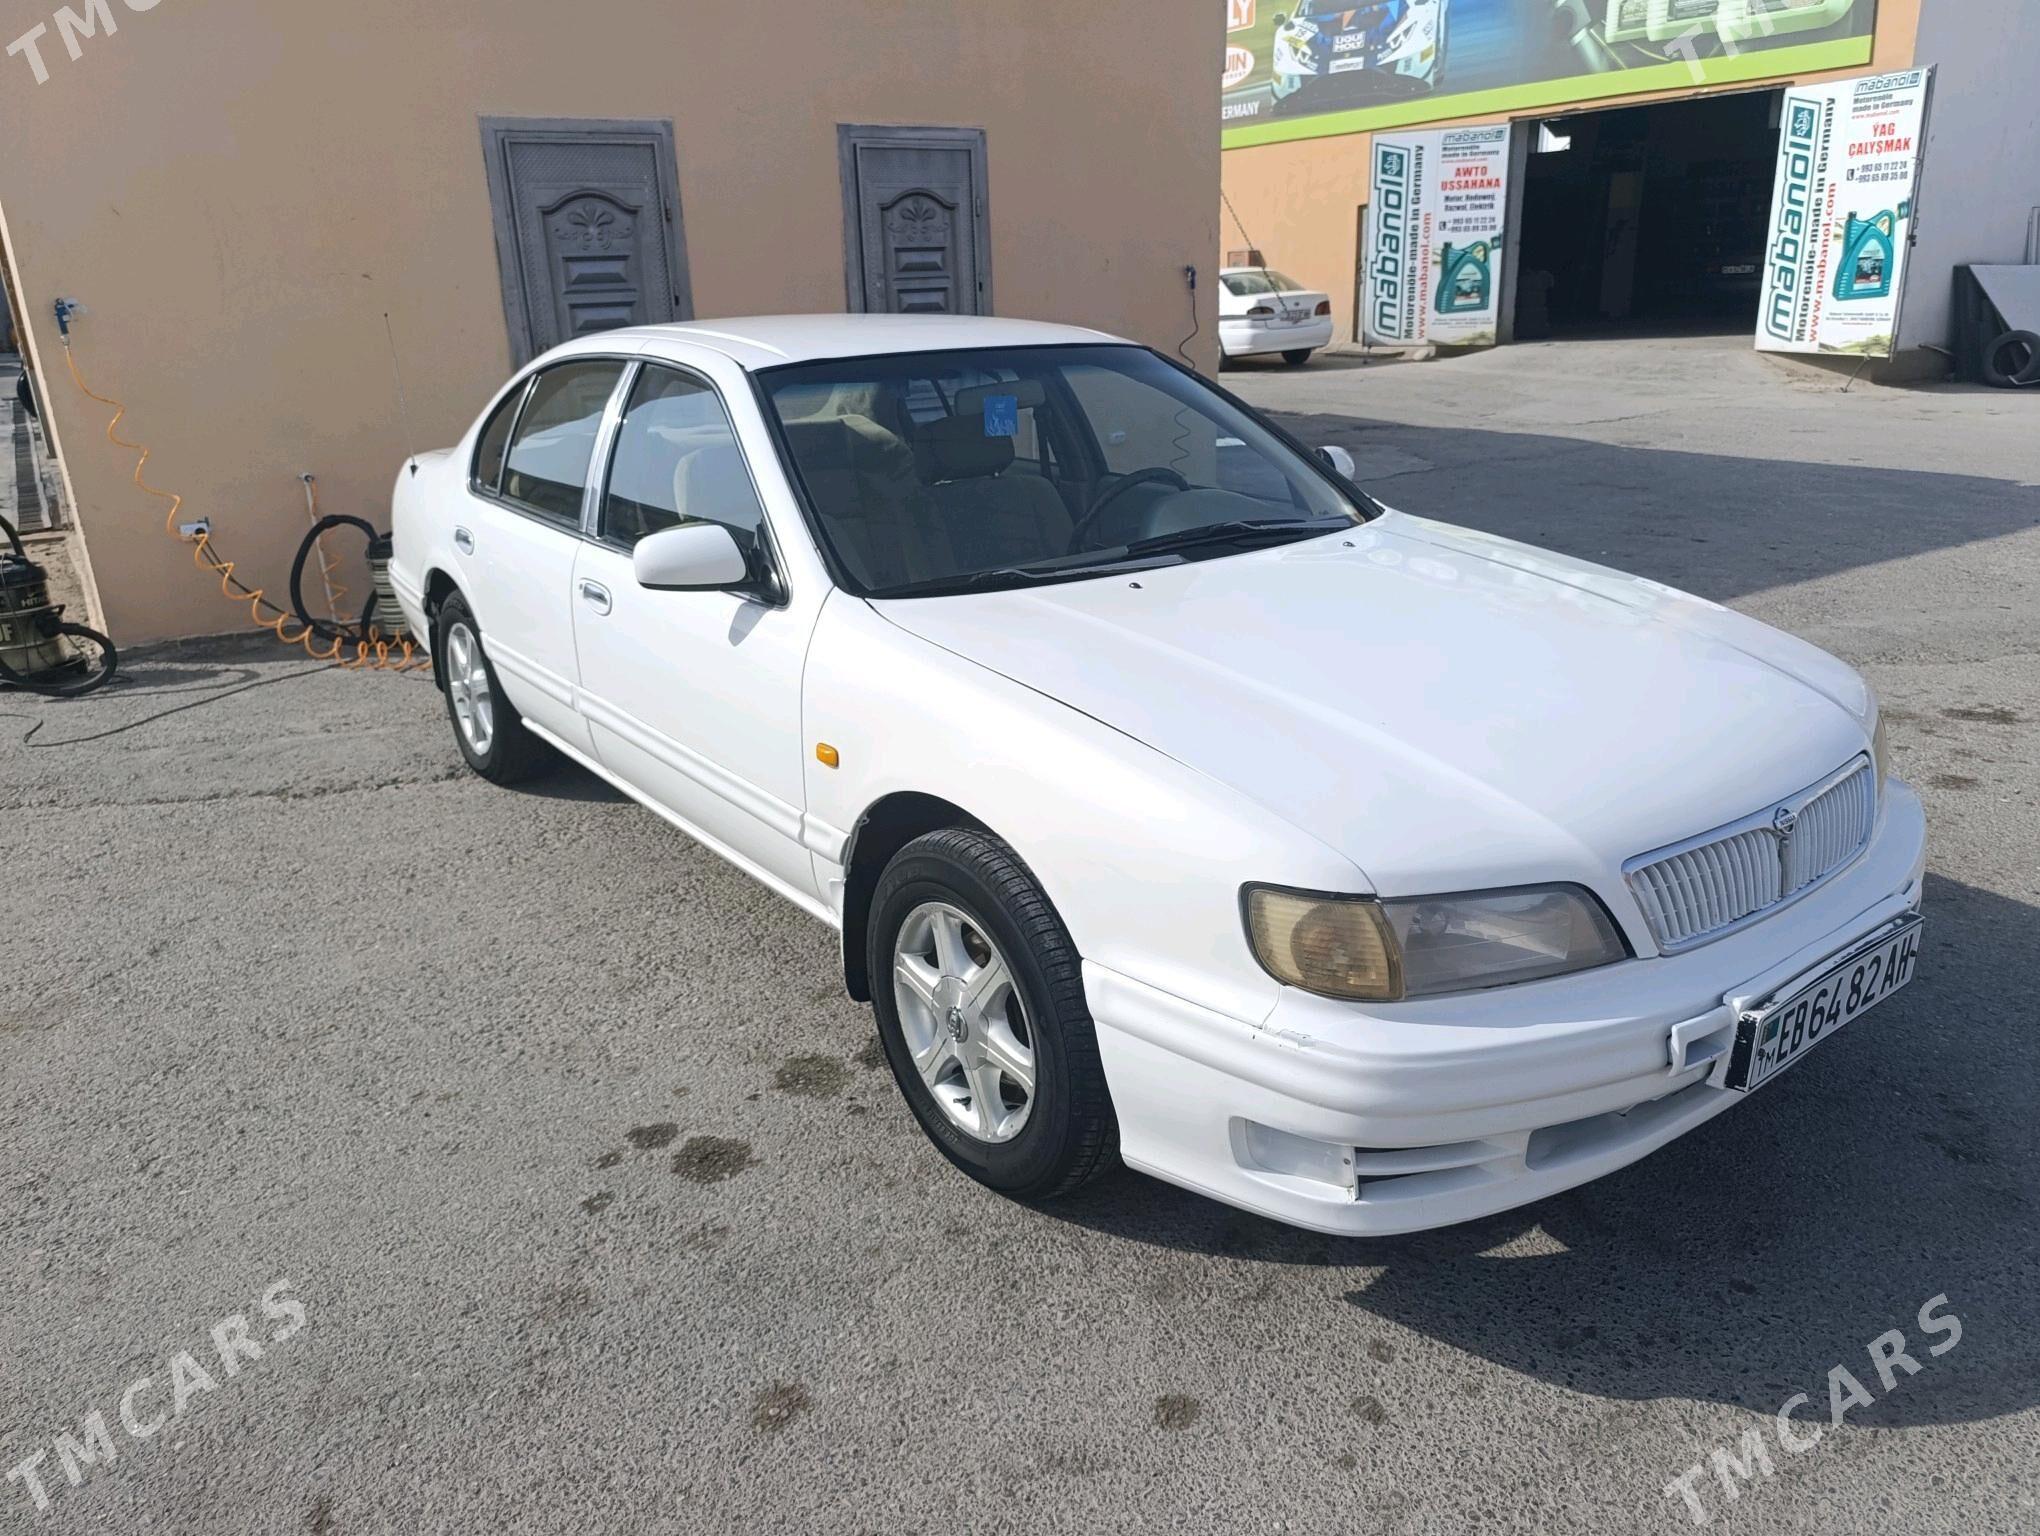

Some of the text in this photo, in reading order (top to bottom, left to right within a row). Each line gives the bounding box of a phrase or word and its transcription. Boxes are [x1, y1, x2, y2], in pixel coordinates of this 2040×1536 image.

[1856, 74, 1910, 92] mabanol
[1817, 98, 1836, 173] Germany
[1411, 145, 1424, 205] Germany
[1441, 178, 1501, 191] USSAHANA
[1455, 166, 1487, 177] AWTO
[1410, 208, 1420, 221] in
[1771, 141, 1811, 332] mabanol
[1376, 178, 1403, 332] mabanol
[1417, 212, 1432, 339] www.mabanol.com
[1809, 183, 1836, 343] www.mabanol.com
